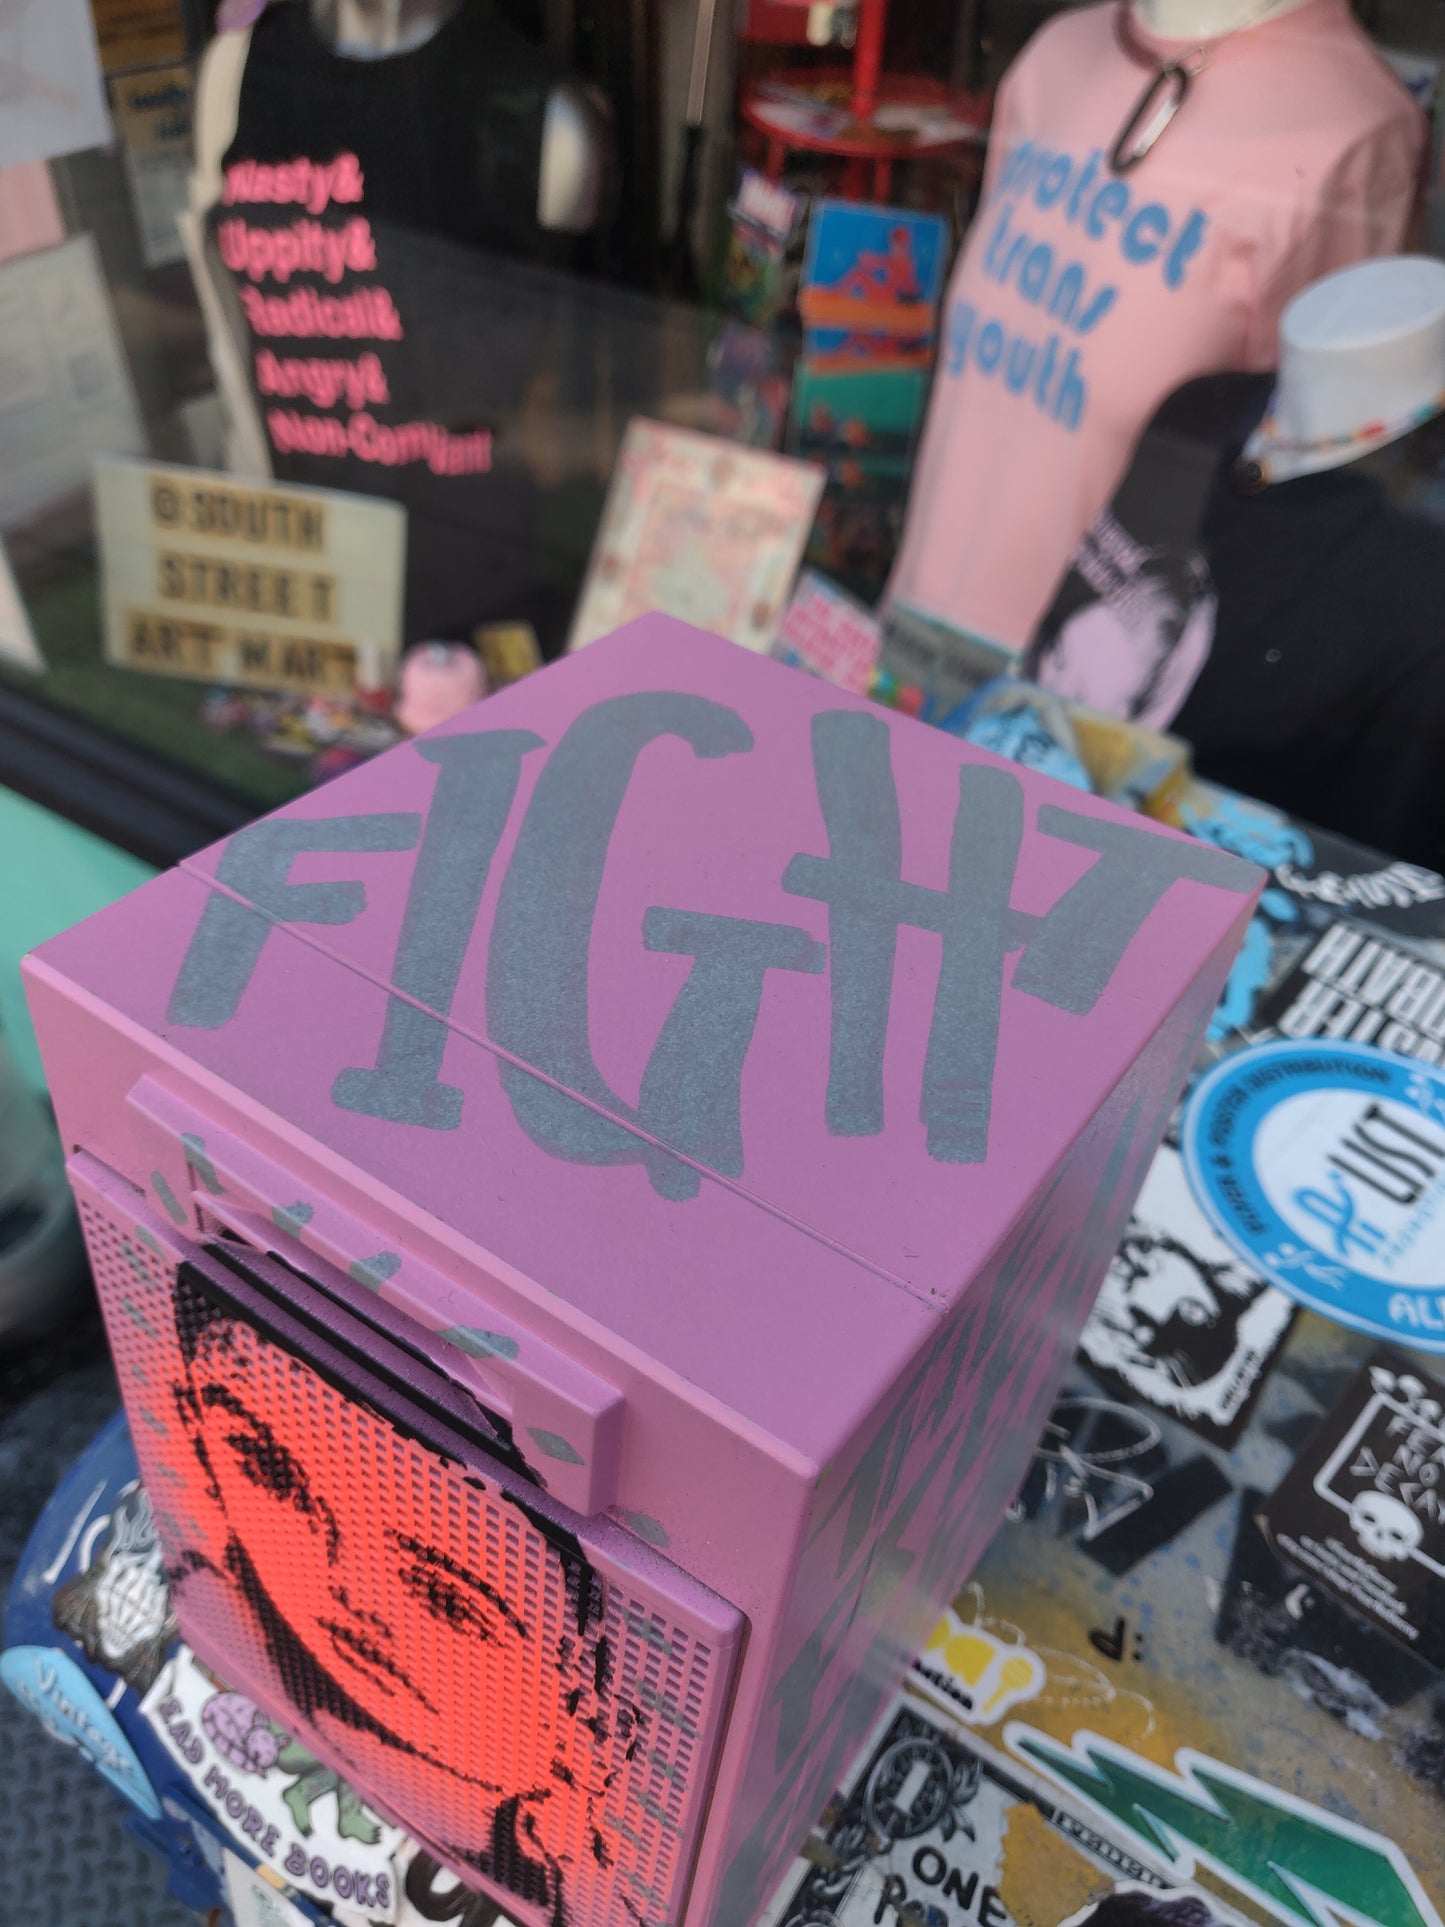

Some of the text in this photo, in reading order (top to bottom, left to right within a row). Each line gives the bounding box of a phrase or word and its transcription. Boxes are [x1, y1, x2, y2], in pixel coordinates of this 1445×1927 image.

[218, 216, 378, 284] Uppity&
[983, 202, 1117, 335] trans
[996, 141, 1208, 292] protect
[255, 348, 390, 410] Angry&
[947, 297, 1087, 433] youth
[161, 556, 332, 624] STREET
[130, 619, 357, 692] ART MART
[165, 689, 1262, 1202] FIGHT
[158, 1698, 204, 1764] EAD
[204, 1765, 282, 1858] MORE
[284, 1842, 390, 1909] BOOKS
[912, 1846, 1007, 1927] ONE
